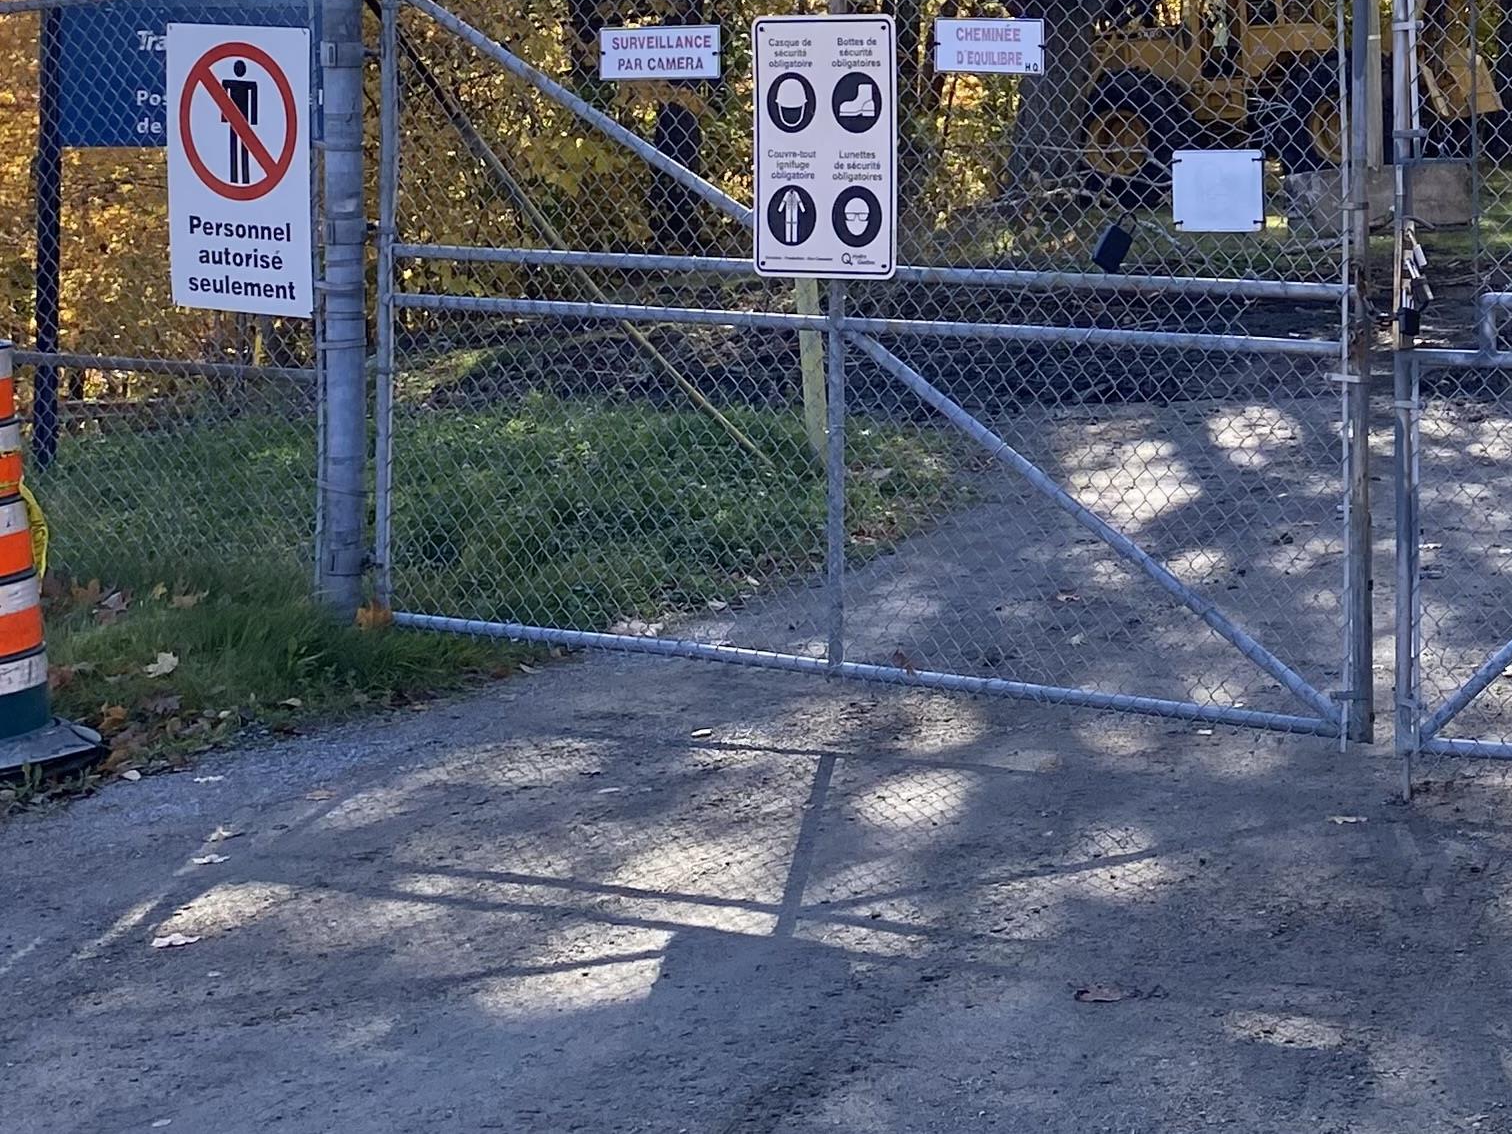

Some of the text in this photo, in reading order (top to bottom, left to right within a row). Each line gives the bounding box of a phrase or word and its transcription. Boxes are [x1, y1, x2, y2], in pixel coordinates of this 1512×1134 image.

[956, 24, 1022, 42] CHEMINÉE
[612, 34, 712, 51] SURVEILLANCE
[768, 38, 812, 48] Casque de
[837, 37, 877, 46] Bottes de
[774, 48, 807, 57] sécurité
[839, 48, 873, 57] sécurité
[618, 56, 704, 71] PAR CAMERA
[768, 60, 813, 69] obligatoire
[831, 59, 881, 69] obligatoires
[136, 117, 162, 134] de
[767, 149, 816, 158] Couvre-tout
[838, 150, 876, 159] Lunettes
[776, 160, 810, 170] ignifuge
[833, 161, 881, 170] de sécurité
[771, 171, 815, 181] obligatoire
[832, 172, 883, 182] obligatoires
[189, 215, 291, 242] Personnel
[198, 247, 283, 270] autorisé
[188, 275, 296, 300] seulement
